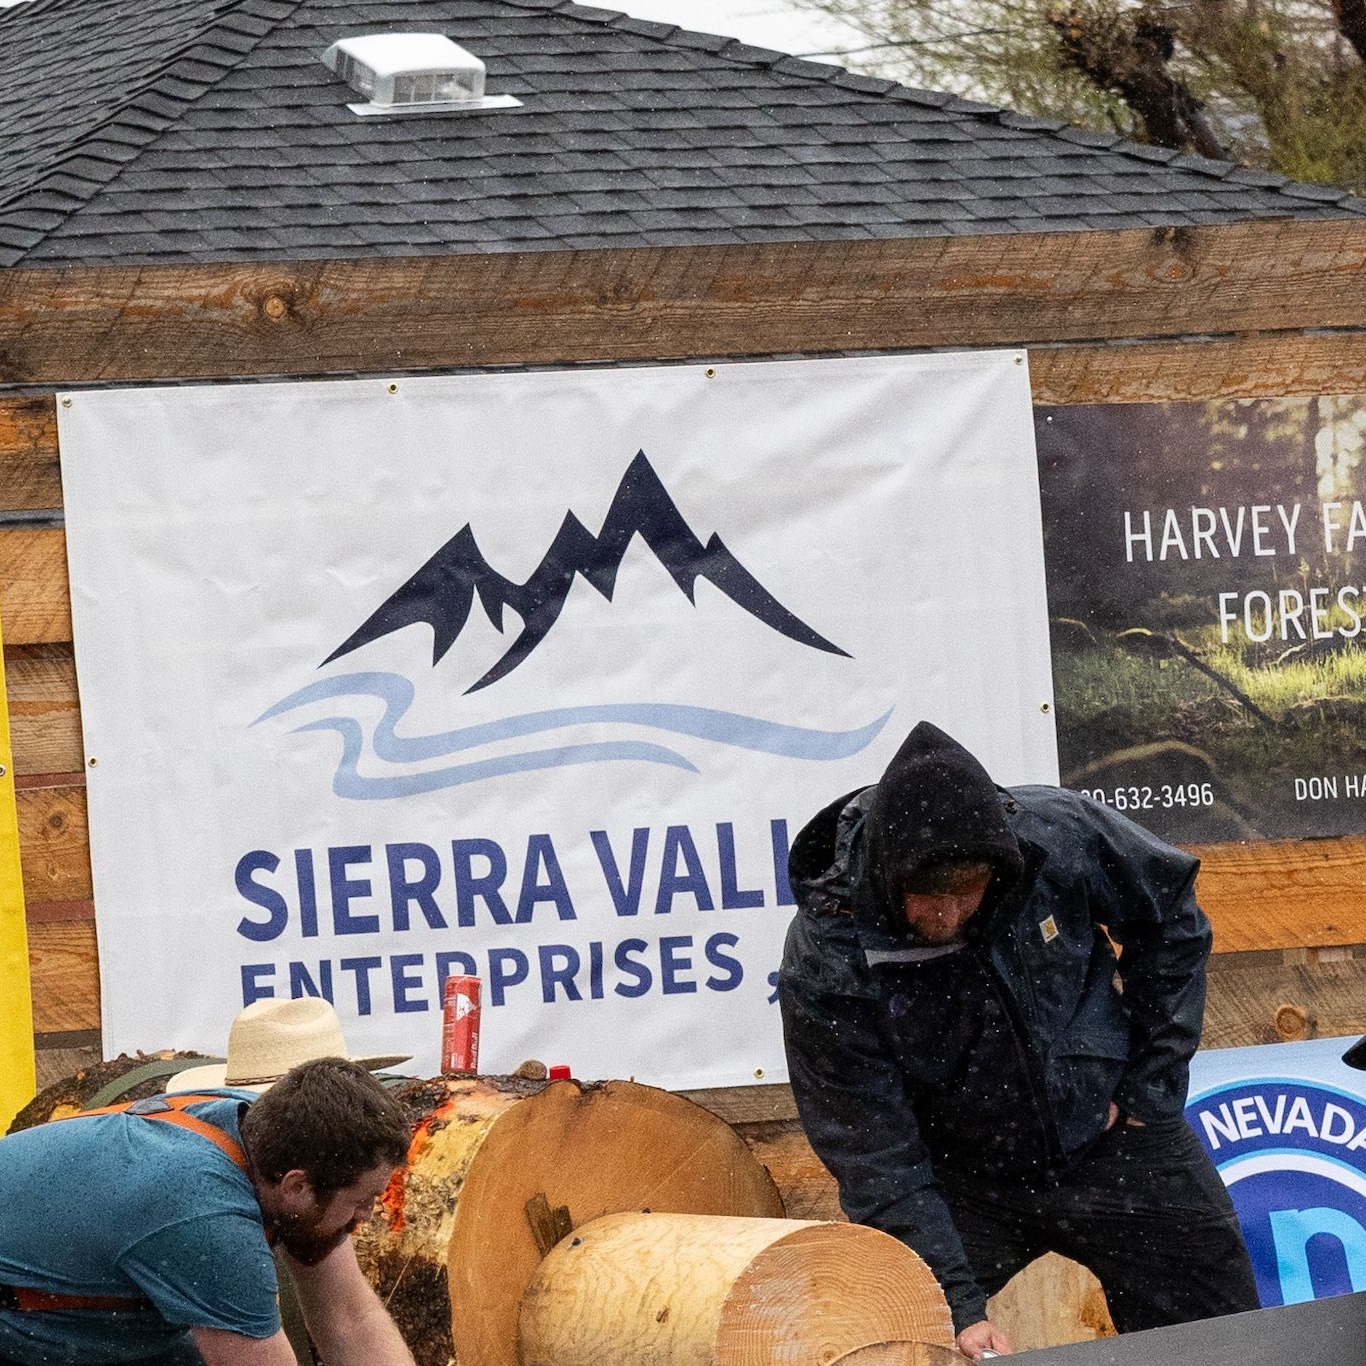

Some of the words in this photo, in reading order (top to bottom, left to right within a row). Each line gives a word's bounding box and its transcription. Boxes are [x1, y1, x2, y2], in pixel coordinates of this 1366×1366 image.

[1124, 503, 1302, 563] HARVEY
[1295, 776, 1338, 800] DON
[235, 834, 578, 942] SIERRA
[589, 818, 798, 917] VALL
